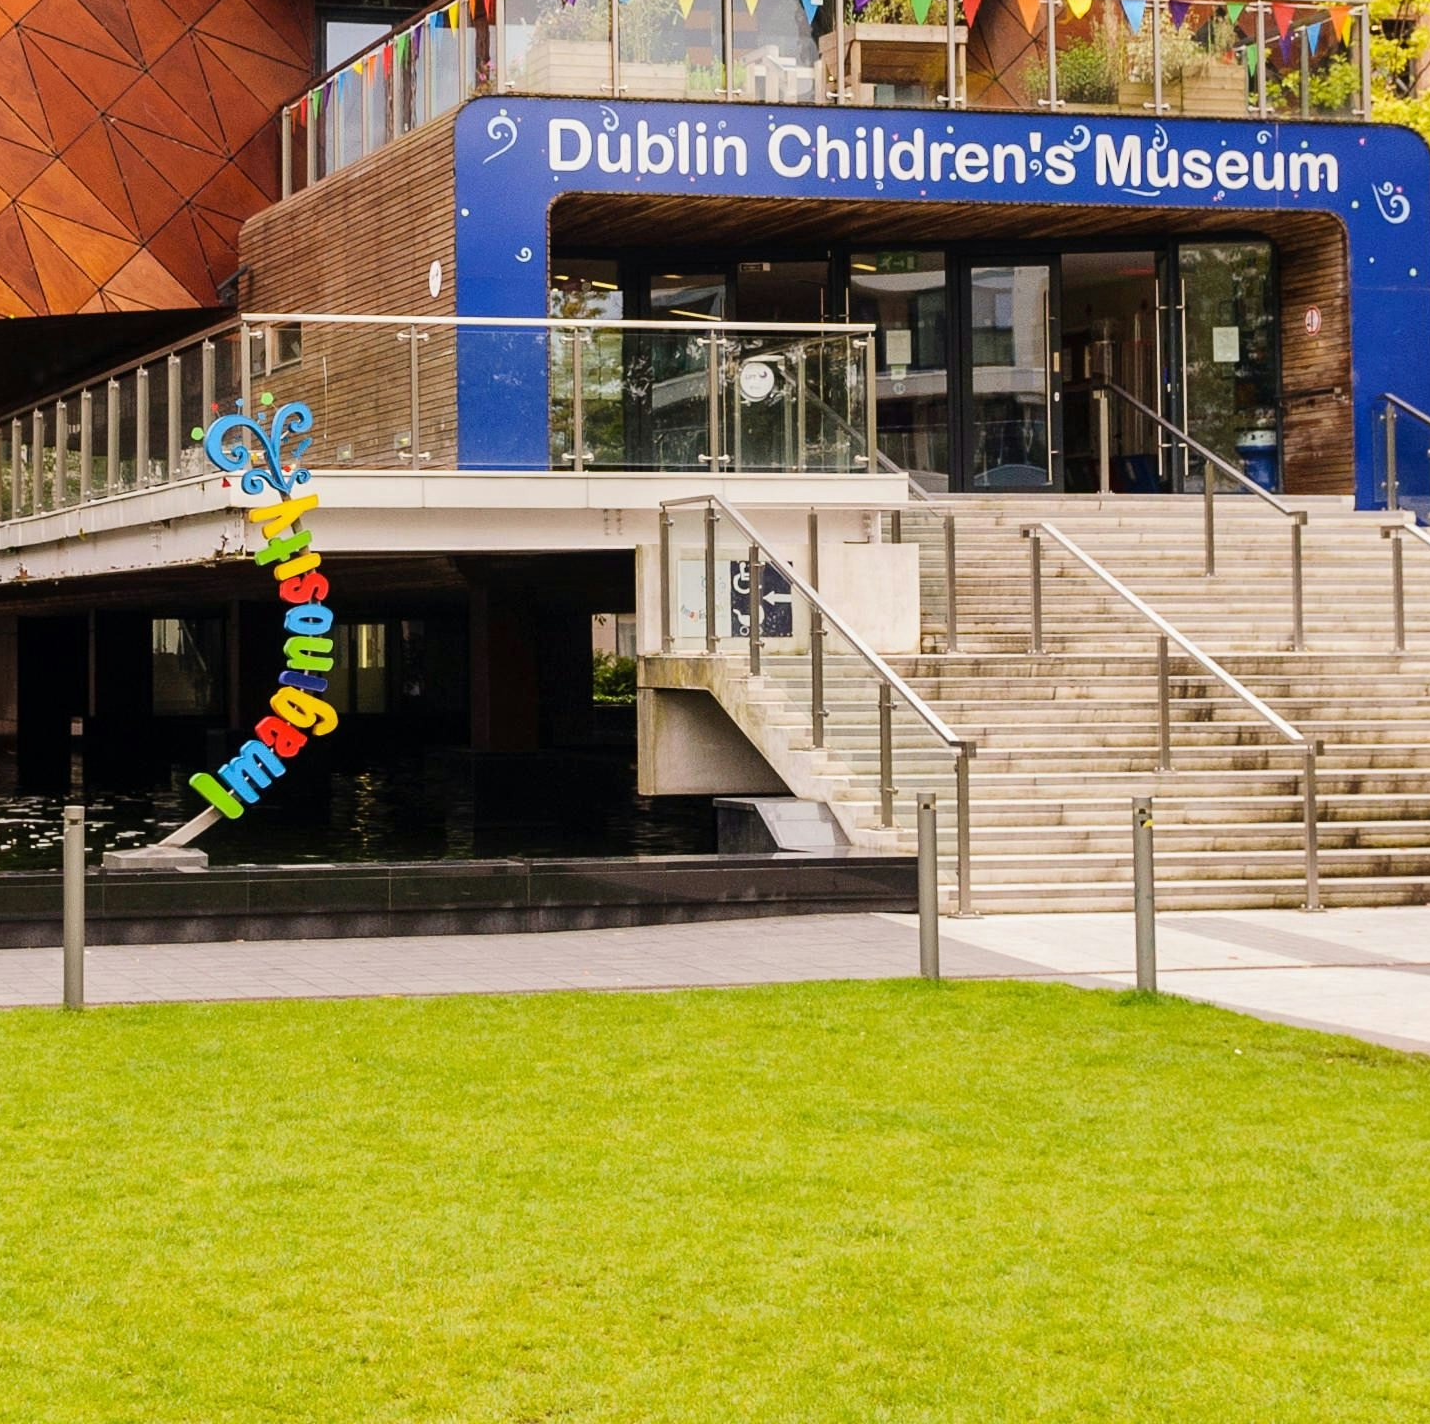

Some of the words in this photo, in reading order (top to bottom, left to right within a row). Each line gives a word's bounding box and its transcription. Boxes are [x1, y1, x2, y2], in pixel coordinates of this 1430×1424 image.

[548, 118, 748, 176] Dublin
[768, 123, 1076, 185] Children's
[1095, 133, 1339, 193] Museum
[189, 493, 338, 820] Imaginosity
